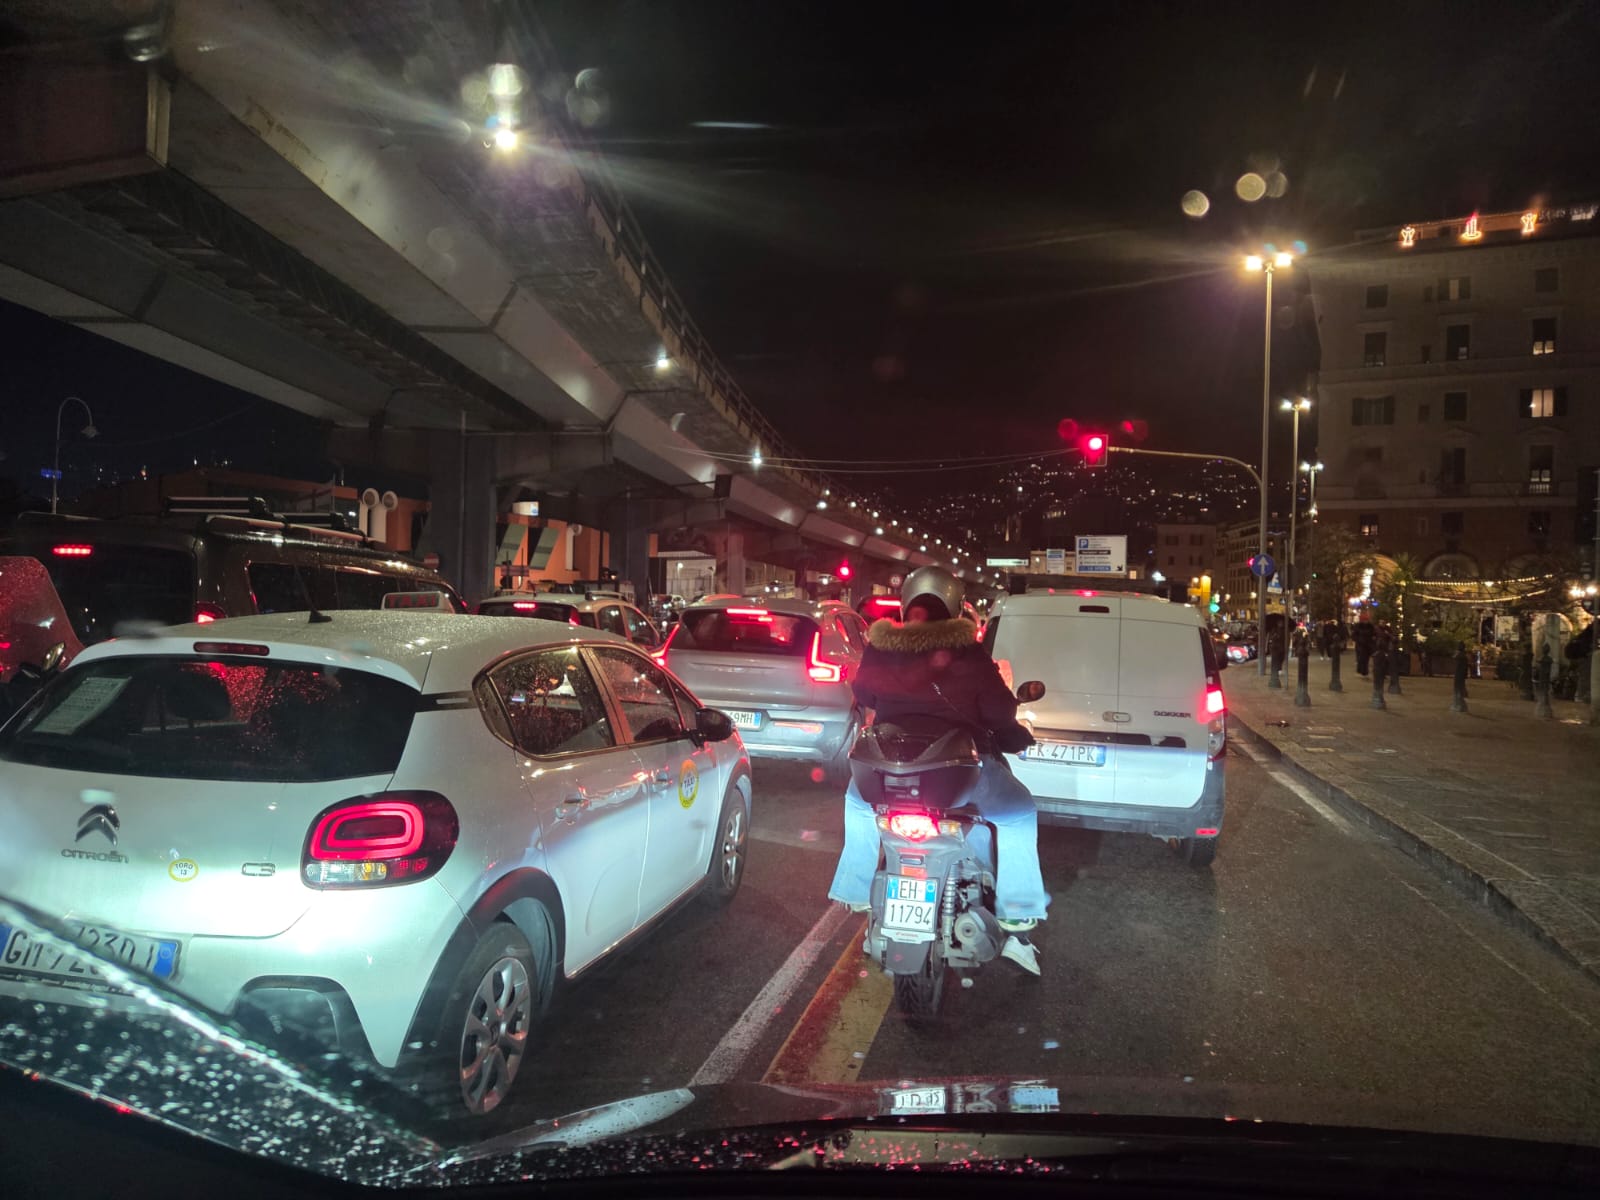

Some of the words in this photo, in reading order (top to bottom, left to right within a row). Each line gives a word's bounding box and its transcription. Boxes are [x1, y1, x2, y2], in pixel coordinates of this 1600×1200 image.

[388, 594, 436, 609] TAXI
[175, 862, 194, 870] TORO
[241, 862, 276, 877] C3
[899, 880, 918, 899] EH
[890, 903, 932, 926] 11794
